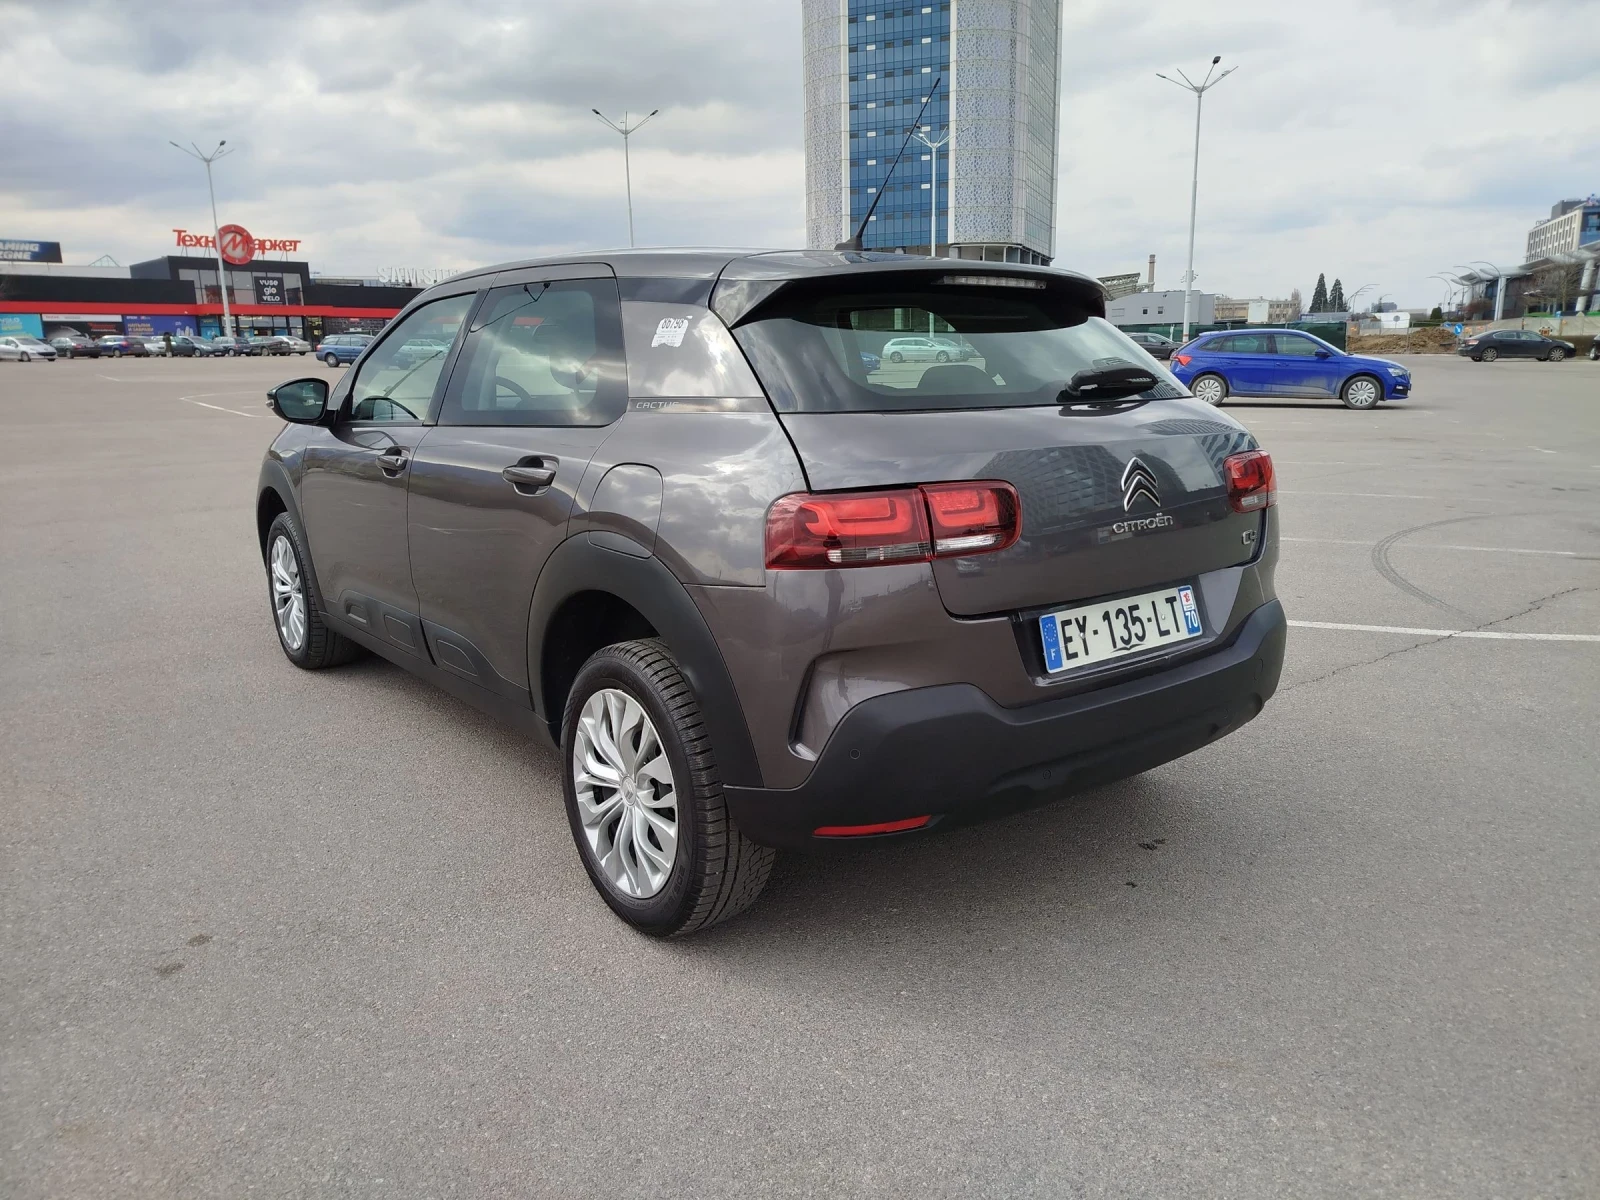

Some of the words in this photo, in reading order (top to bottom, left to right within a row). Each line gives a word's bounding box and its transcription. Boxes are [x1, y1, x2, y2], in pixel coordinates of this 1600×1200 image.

[636, 401, 679, 409] CACTUS
[1185, 610, 1199, 629] 70
[1060, 595, 1181, 661] EY-135-LT
[1051, 648, 1057, 661] F
